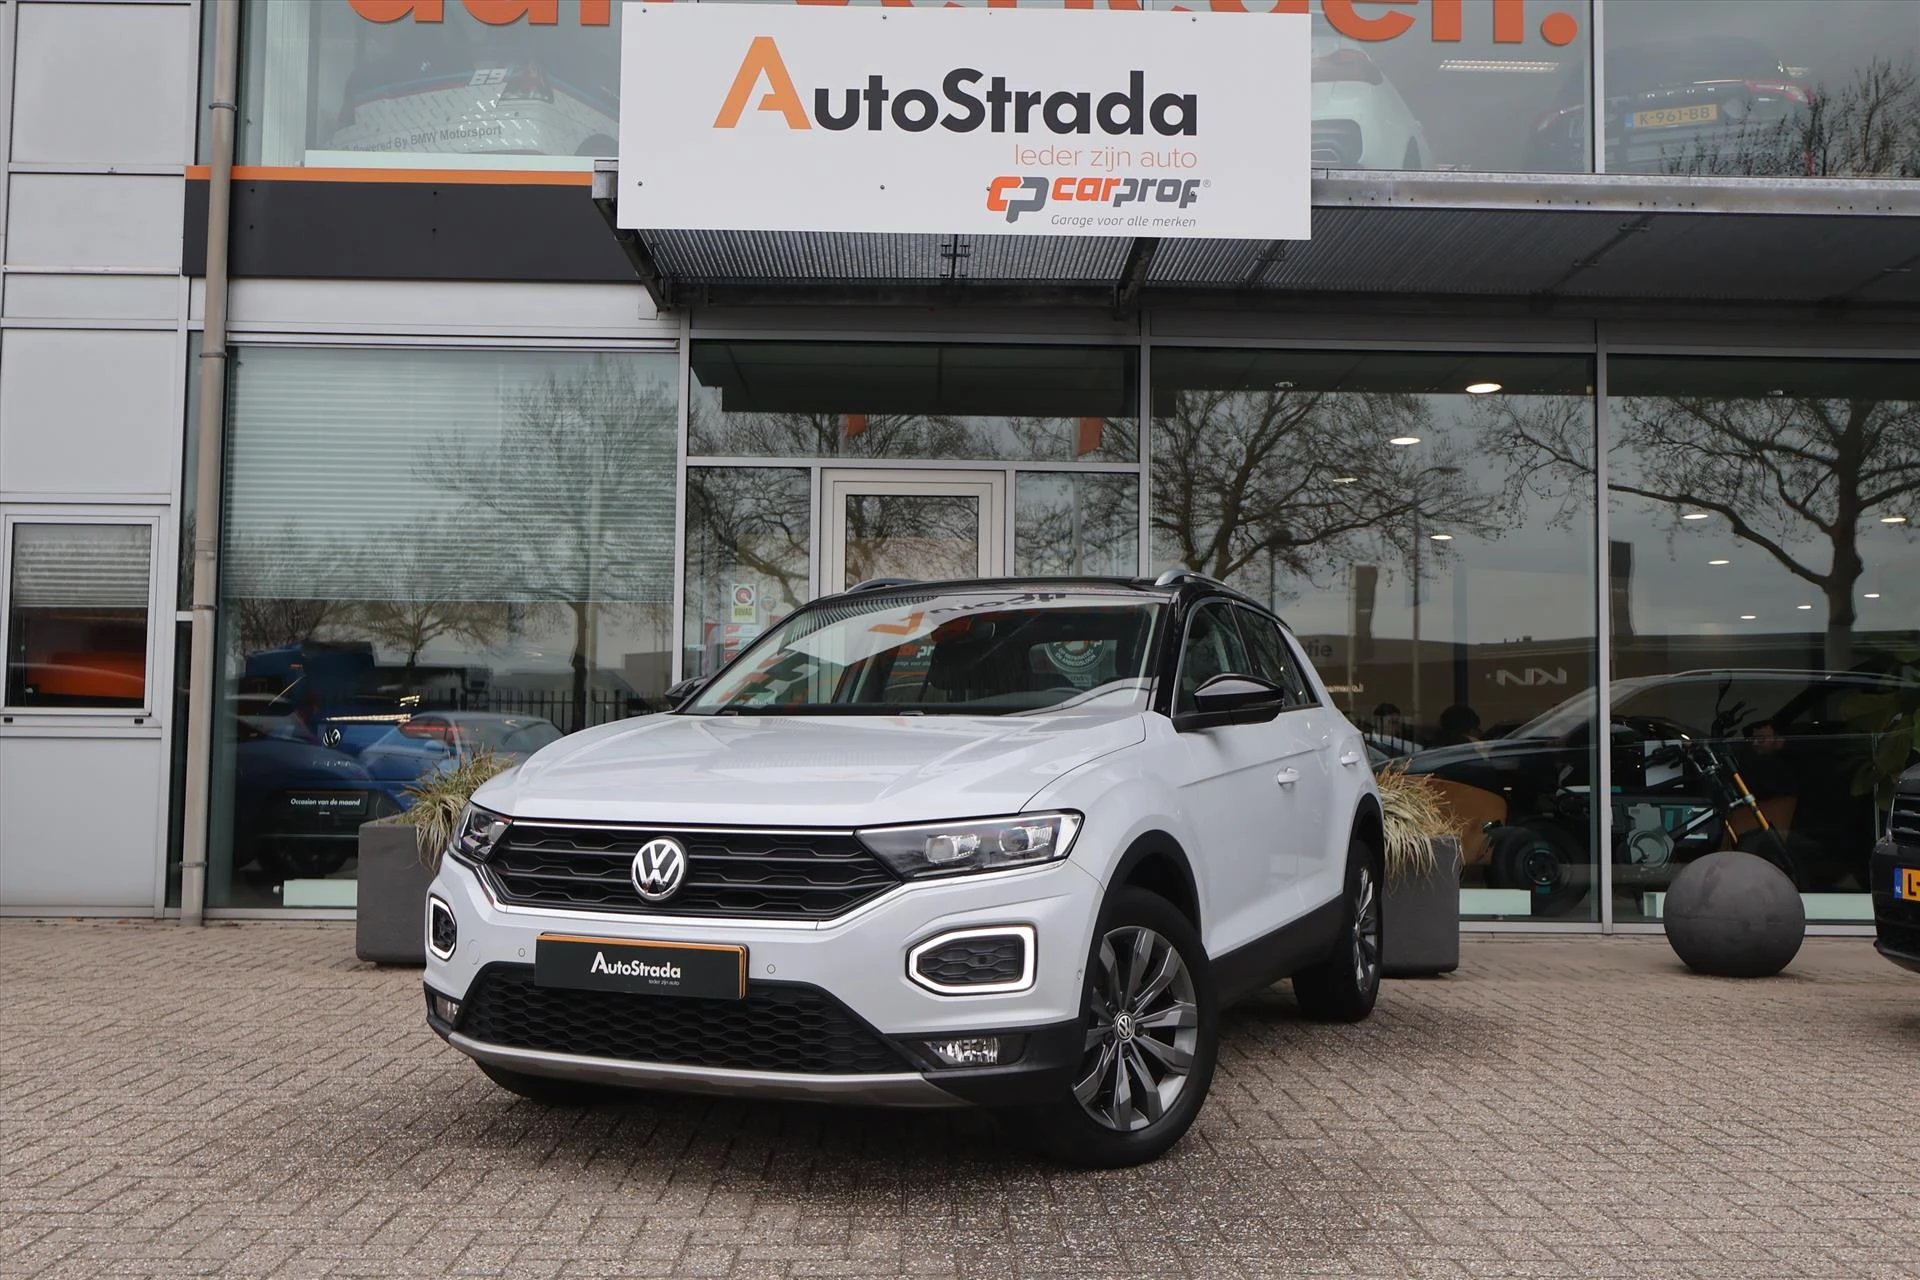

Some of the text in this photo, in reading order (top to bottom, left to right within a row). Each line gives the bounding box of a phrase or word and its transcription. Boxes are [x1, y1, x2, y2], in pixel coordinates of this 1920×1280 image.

[711, 35, 1198, 136] AutoStrada
[394, 136, 408, 146] By
[411, 131, 437, 145] BMW
[440, 124, 503, 141] Motorsport
[1014, 144, 1198, 172] Ieder zijn auto
[1051, 215, 1197, 228] Garage voor alle merken
[330, 798, 338, 806] de
[590, 951, 681, 979] AutoStrada
